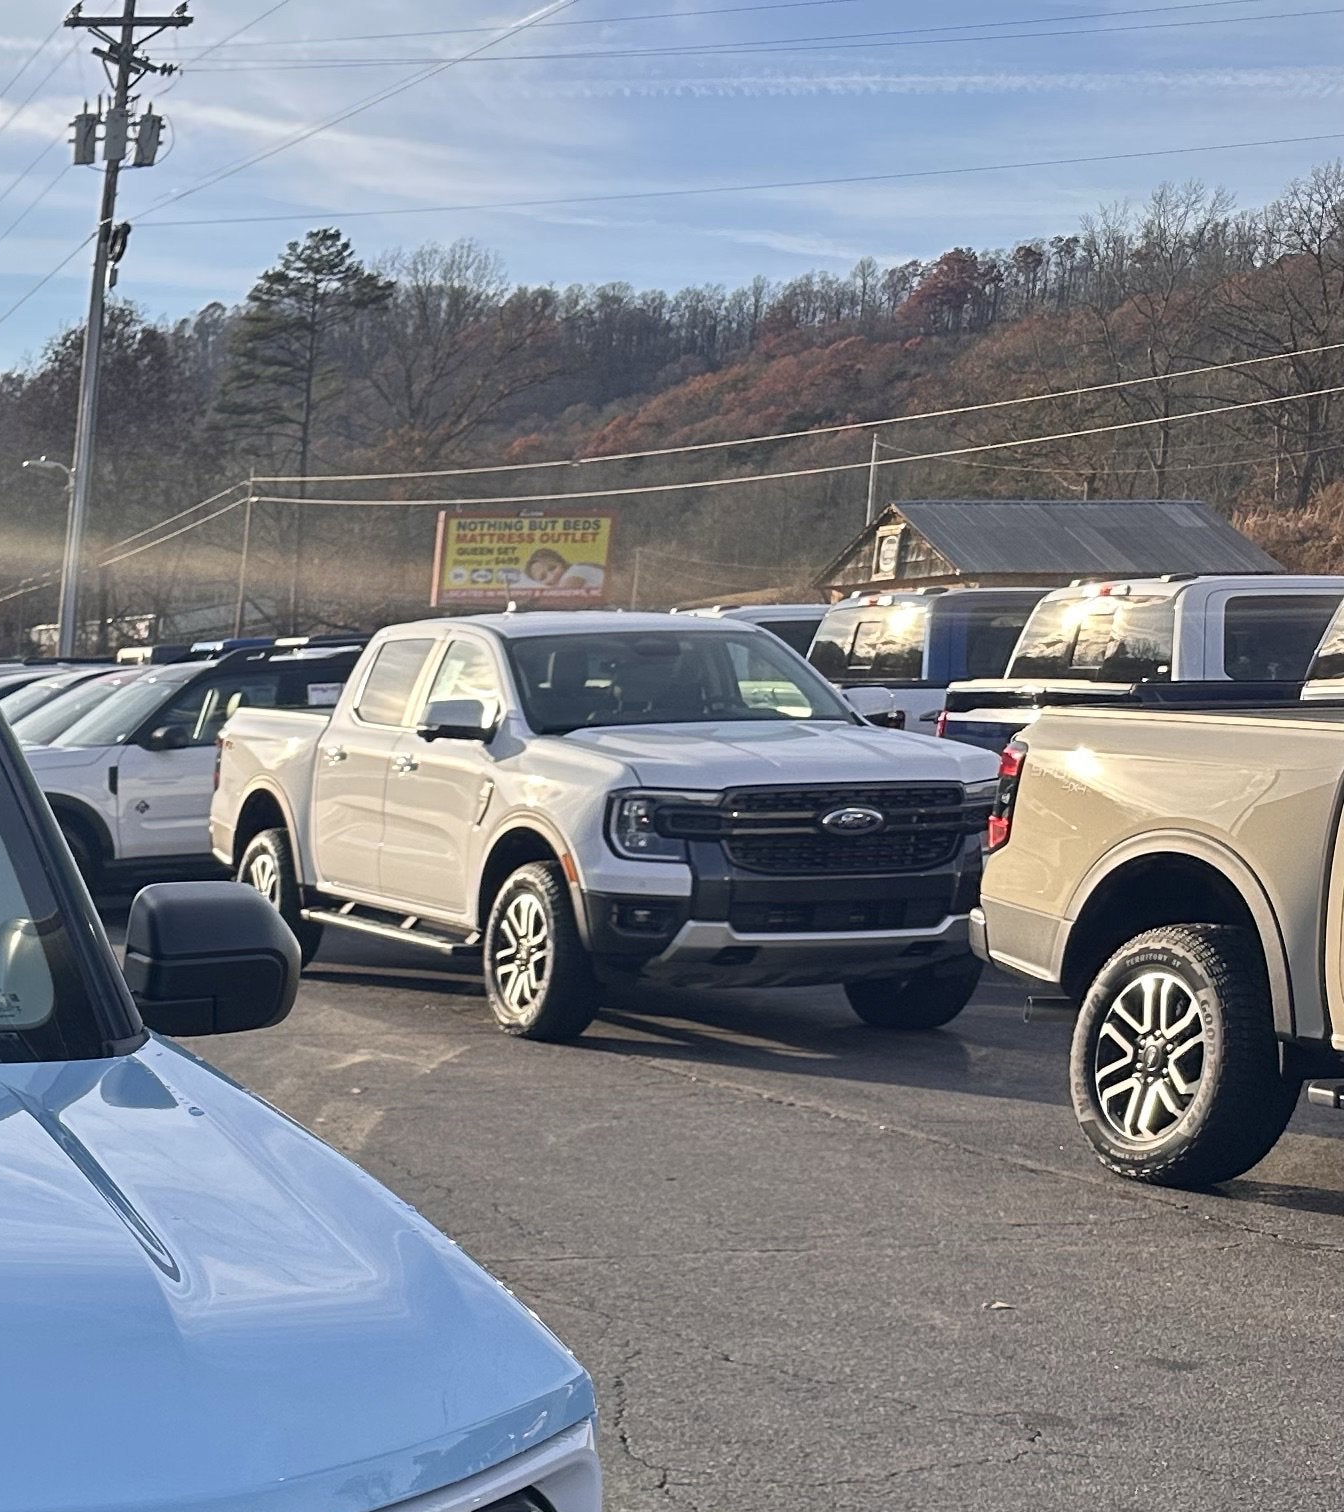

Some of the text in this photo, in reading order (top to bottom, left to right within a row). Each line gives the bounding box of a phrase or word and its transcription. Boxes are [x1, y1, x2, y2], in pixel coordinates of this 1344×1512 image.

[456, 519, 601, 532] NOTHING BUT BEDS
[455, 532, 599, 544] MATTRESS OUTLET
[456, 546, 518, 556] QUEEN SET
